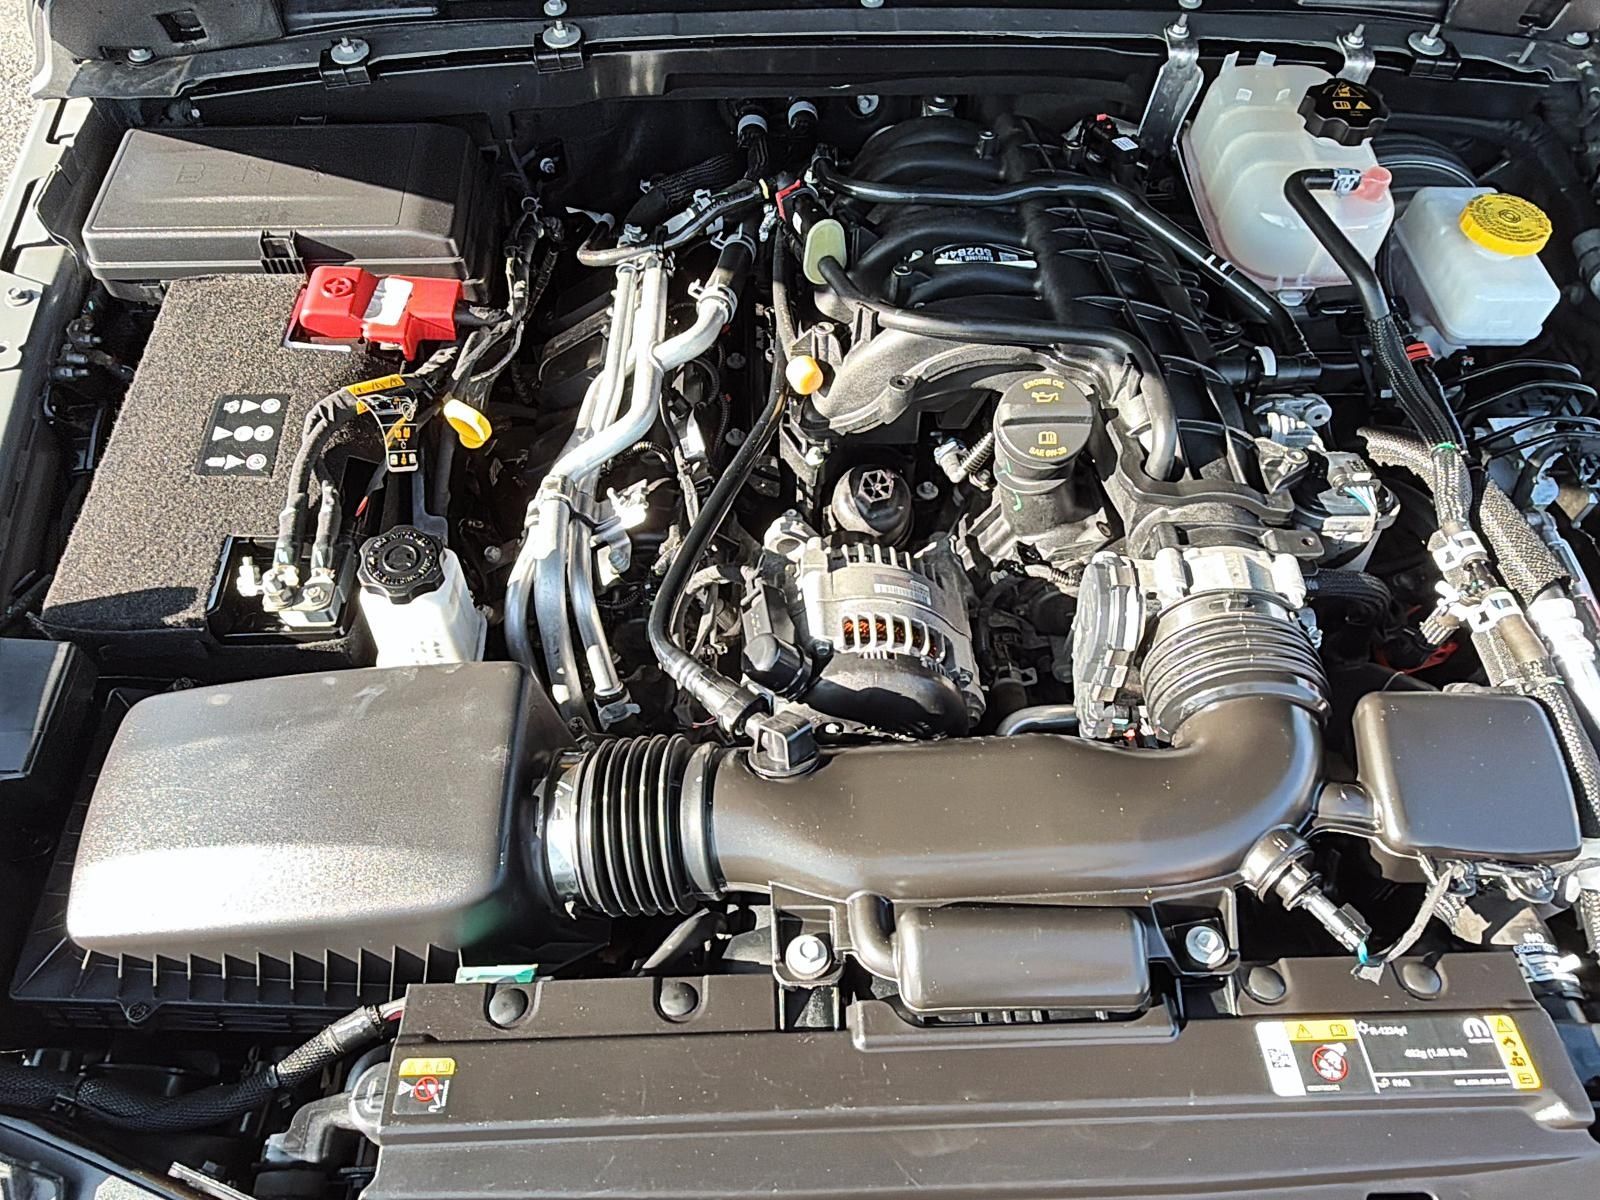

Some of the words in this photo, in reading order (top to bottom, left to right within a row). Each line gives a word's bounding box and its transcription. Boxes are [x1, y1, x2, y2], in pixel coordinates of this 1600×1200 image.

[1022, 378, 1052, 390] ENGINE
[1052, 379, 1065, 390] OIL
[1028, 446, 1045, 457] SAE
